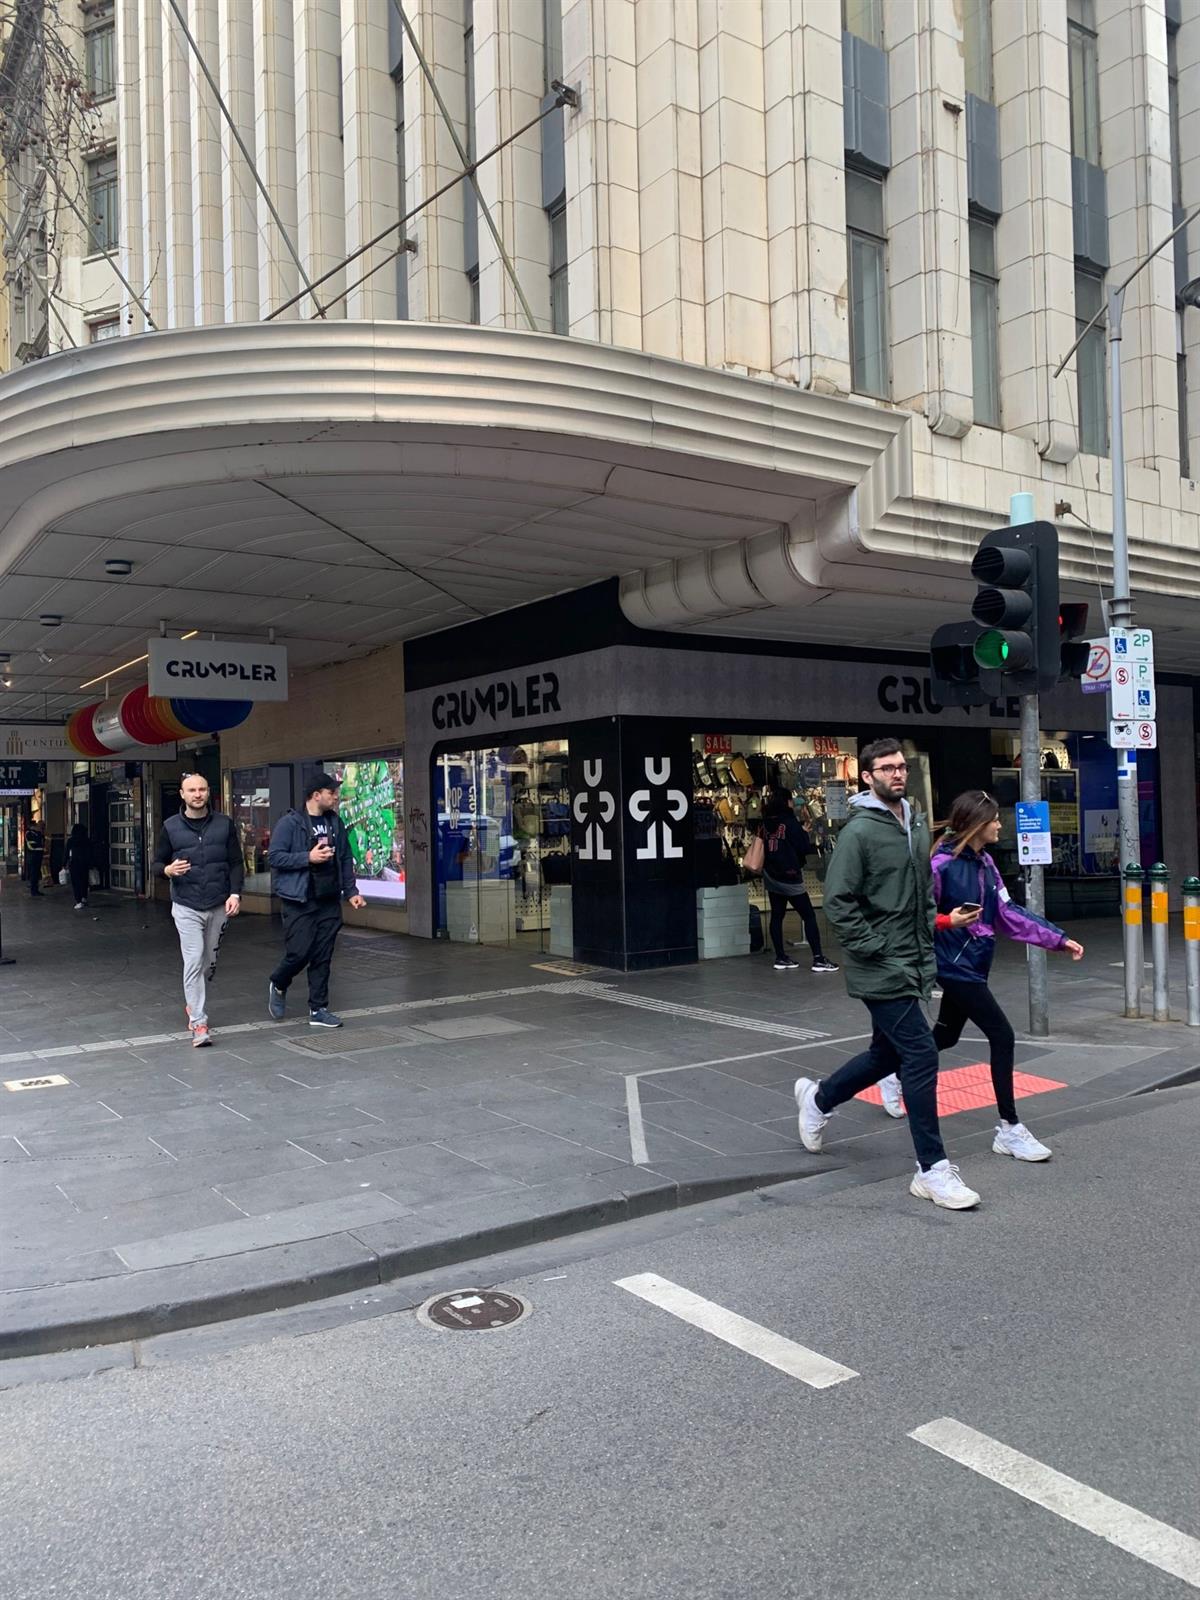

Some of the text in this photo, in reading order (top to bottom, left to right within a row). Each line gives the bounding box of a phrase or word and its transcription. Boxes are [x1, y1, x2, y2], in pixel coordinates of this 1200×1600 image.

[1133, 634, 1151, 648] 2P
[166, 660, 277, 682] CRUMPLER
[1138, 665, 1148, 678] P
[432, 672, 561, 730] CRUMPLER
[706, 736, 731, 750] SALE
[815, 739, 838, 751] SALE
